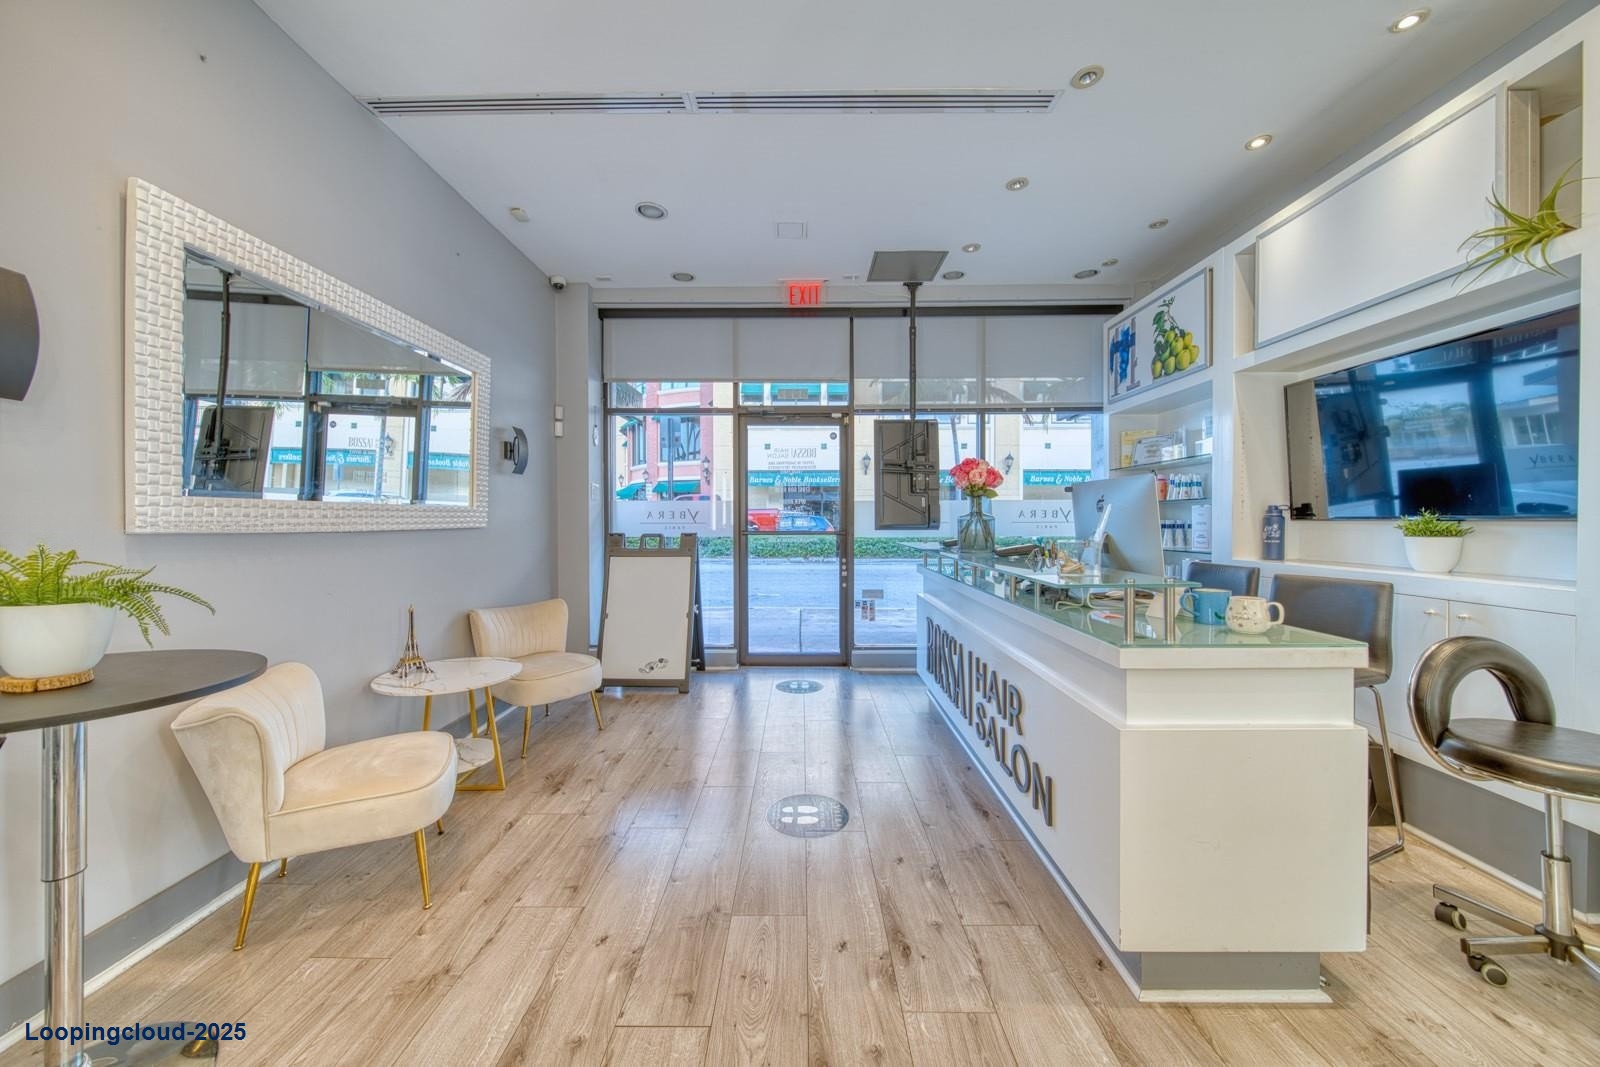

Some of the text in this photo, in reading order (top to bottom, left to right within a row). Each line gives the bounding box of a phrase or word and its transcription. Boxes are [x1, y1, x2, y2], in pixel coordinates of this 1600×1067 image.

[788, 283, 822, 305] EXIT
[1030, 475, 1054, 483] Barnes
[1055, 474, 1063, 485] &
[1064, 475, 1083, 483] Noble
[975, 656, 1024, 736] HAIR
[975, 702, 1053, 827] SALON
